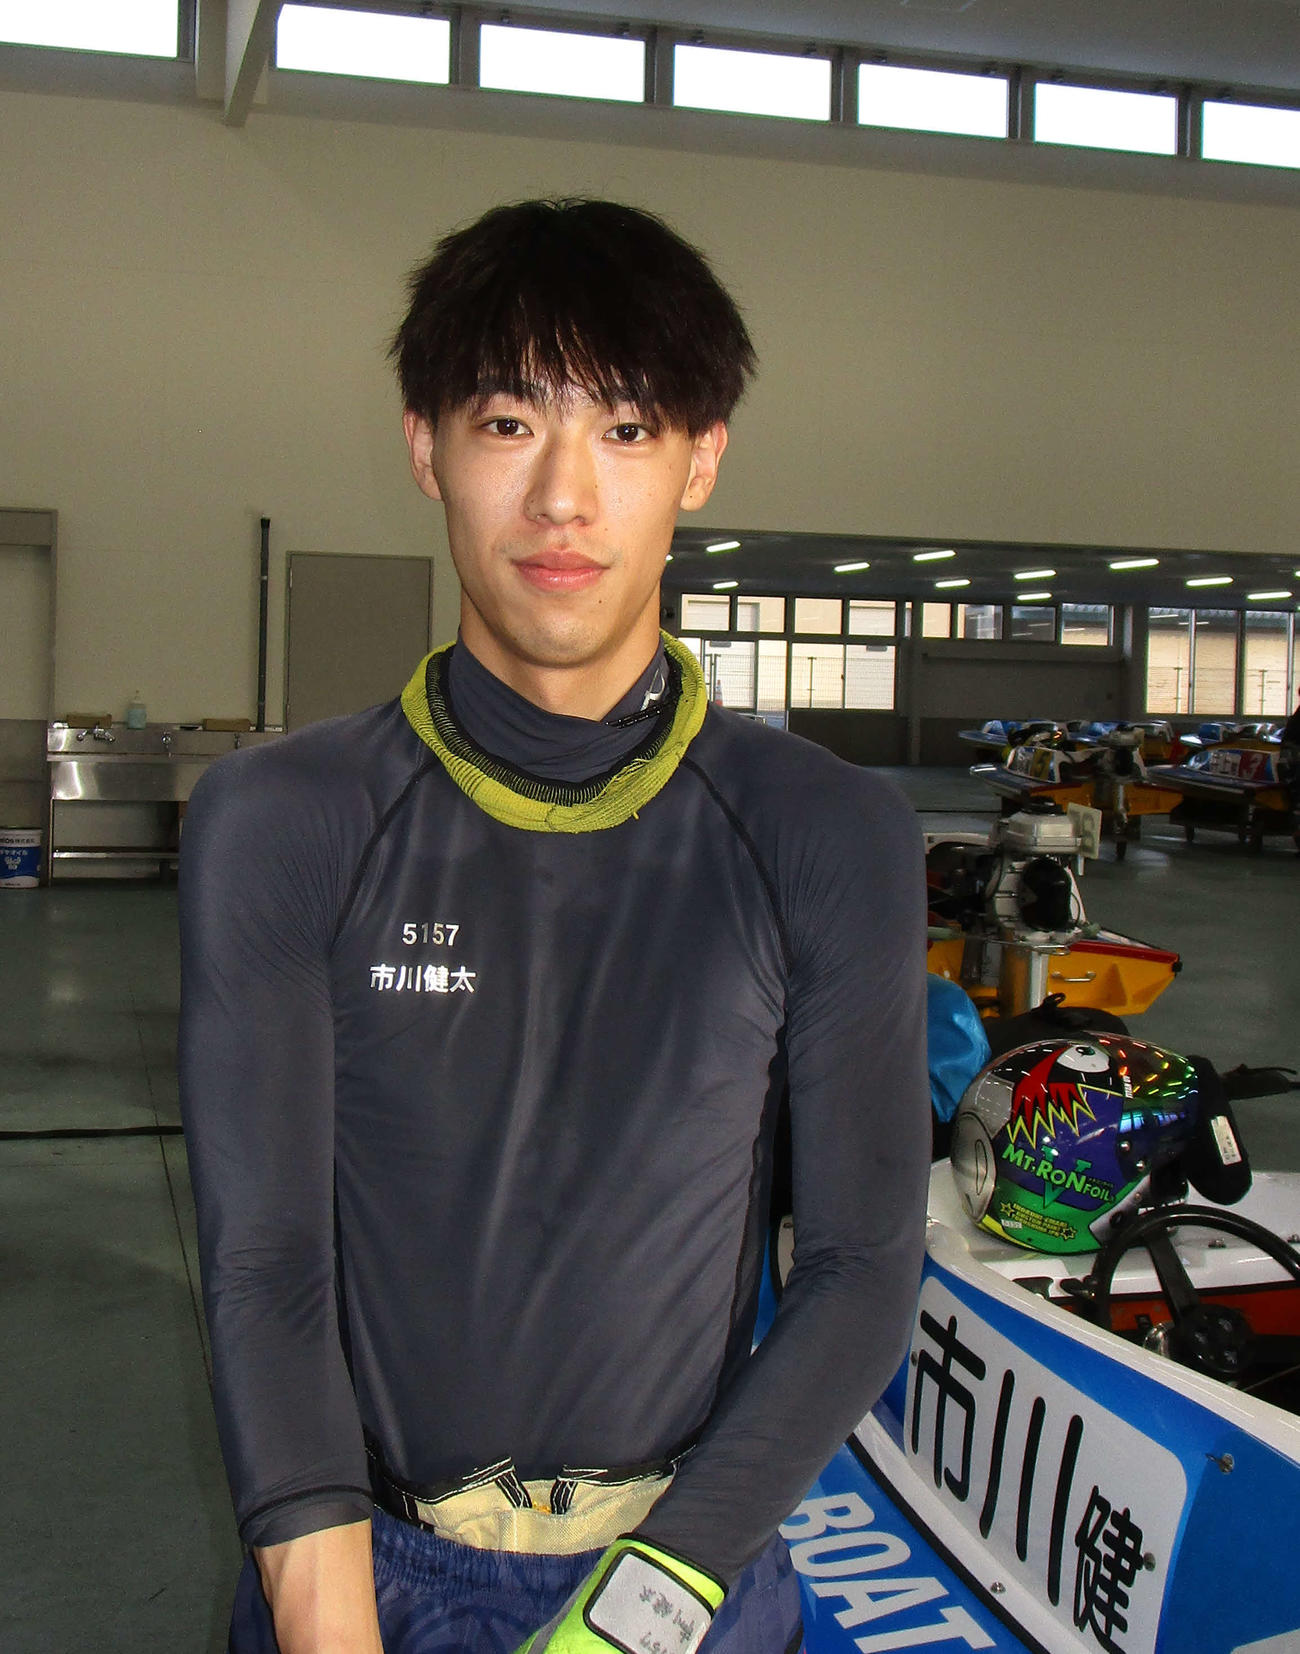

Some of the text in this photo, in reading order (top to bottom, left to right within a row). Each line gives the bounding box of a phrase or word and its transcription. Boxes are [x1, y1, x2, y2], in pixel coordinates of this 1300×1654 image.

[369, 963, 476, 993] 市川健太
[402, 923, 459, 946] 5157
[911, 1309, 1145, 1654] 市川健
[778, 1491, 998, 1654] BOAT
